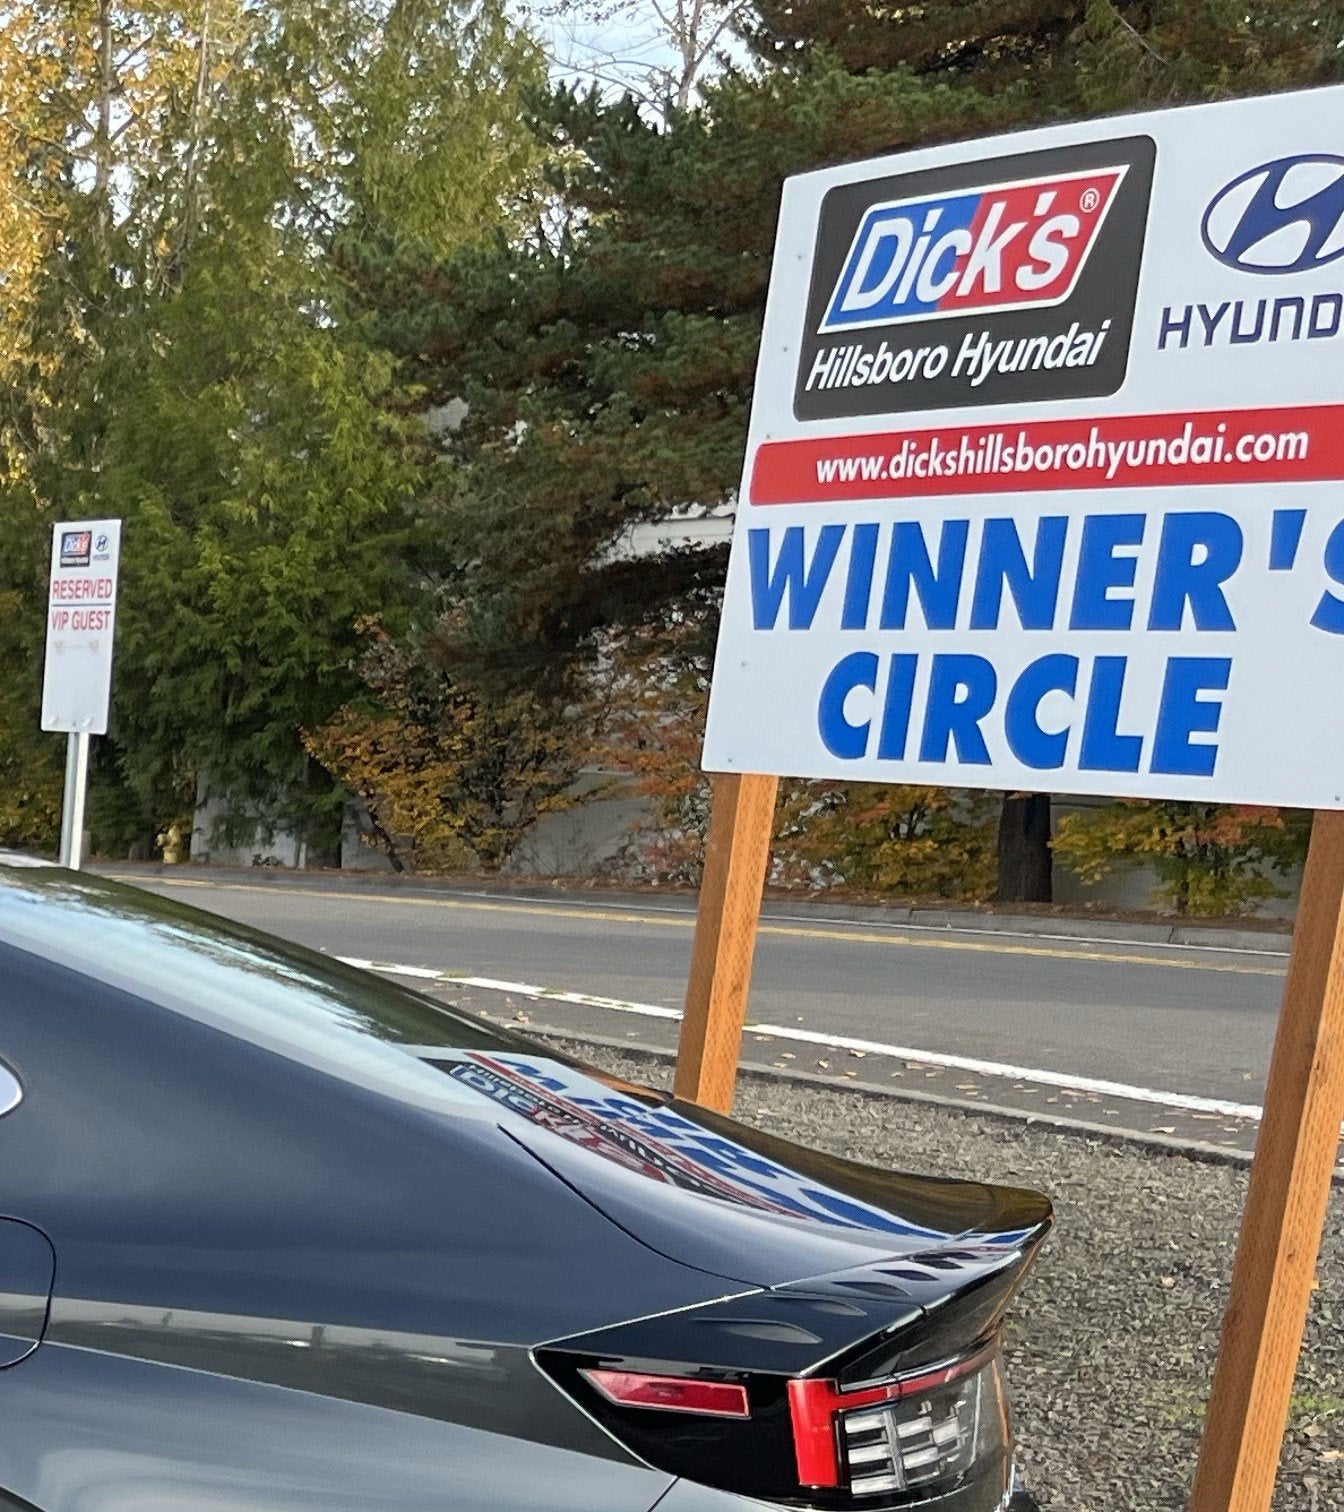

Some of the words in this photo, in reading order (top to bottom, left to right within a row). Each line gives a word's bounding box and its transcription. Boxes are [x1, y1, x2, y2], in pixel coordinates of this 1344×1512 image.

[840, 190, 1081, 312] Dick's
[805, 341, 949, 391] Hillsboro
[950, 318, 1113, 387] Hyundai
[816, 421, 1309, 484] www.dickshillsborohyundai.com
[51, 610, 69, 631] VIP
[71, 610, 111, 630] GUEST
[52, 578, 113, 600] RESERVED
[817, 651, 1234, 777] CIRCLE
